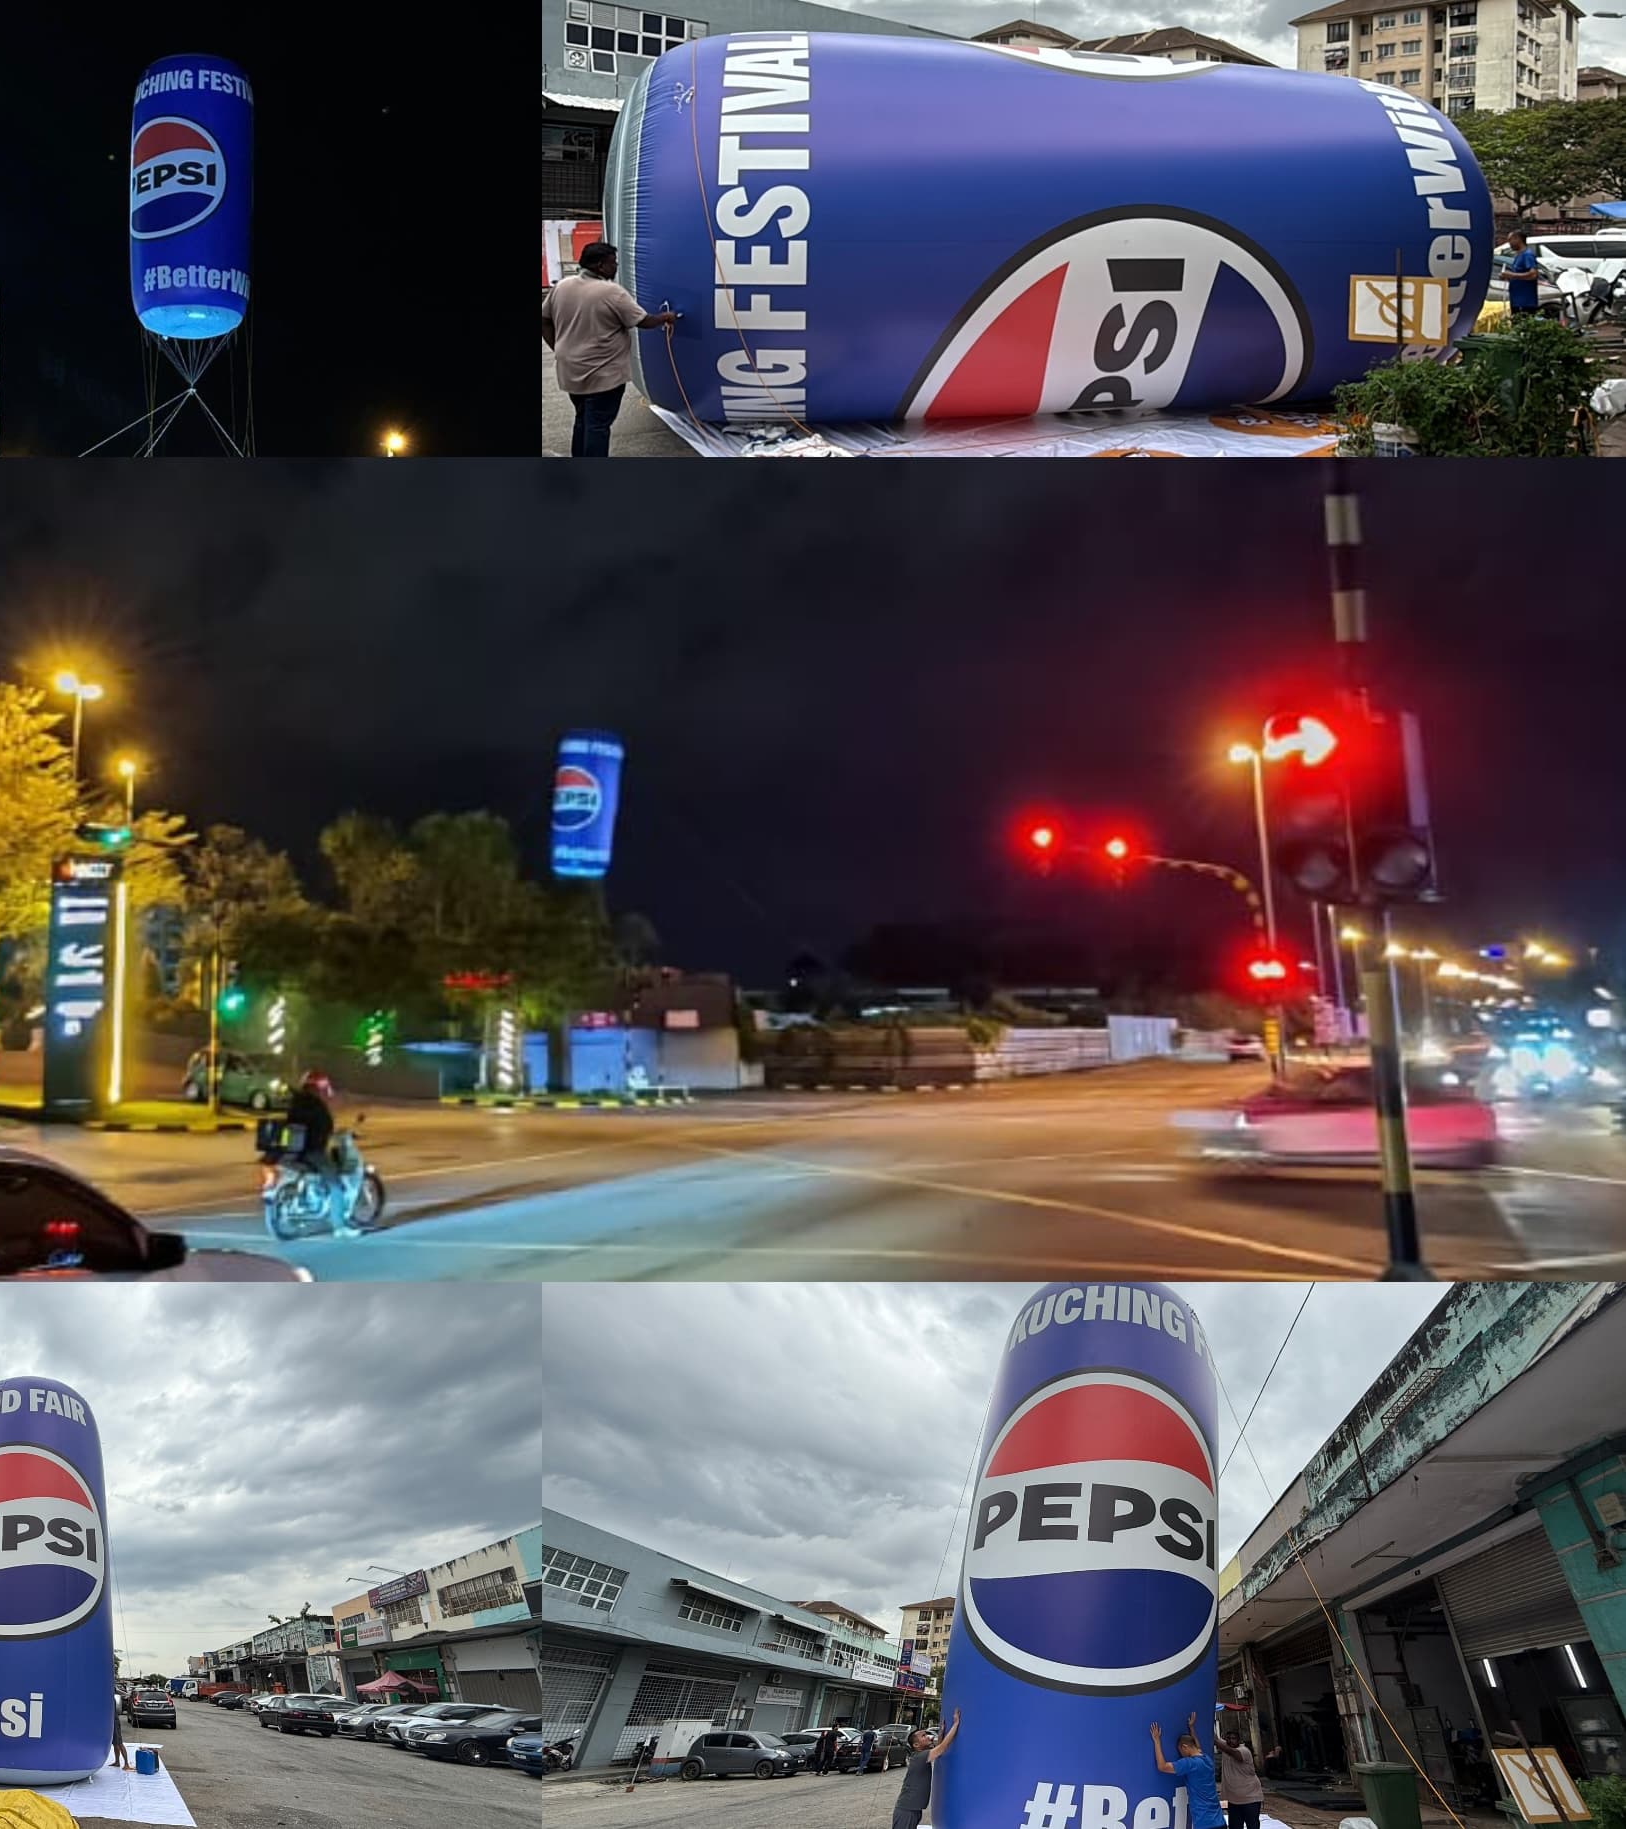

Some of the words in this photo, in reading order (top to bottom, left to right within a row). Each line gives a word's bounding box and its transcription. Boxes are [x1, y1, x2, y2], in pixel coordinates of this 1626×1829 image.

[1009, 1285, 1187, 1352] KUCHING
[29, 1388, 87, 1427] FAIR
[973, 1483, 1215, 1571] PEPSI
